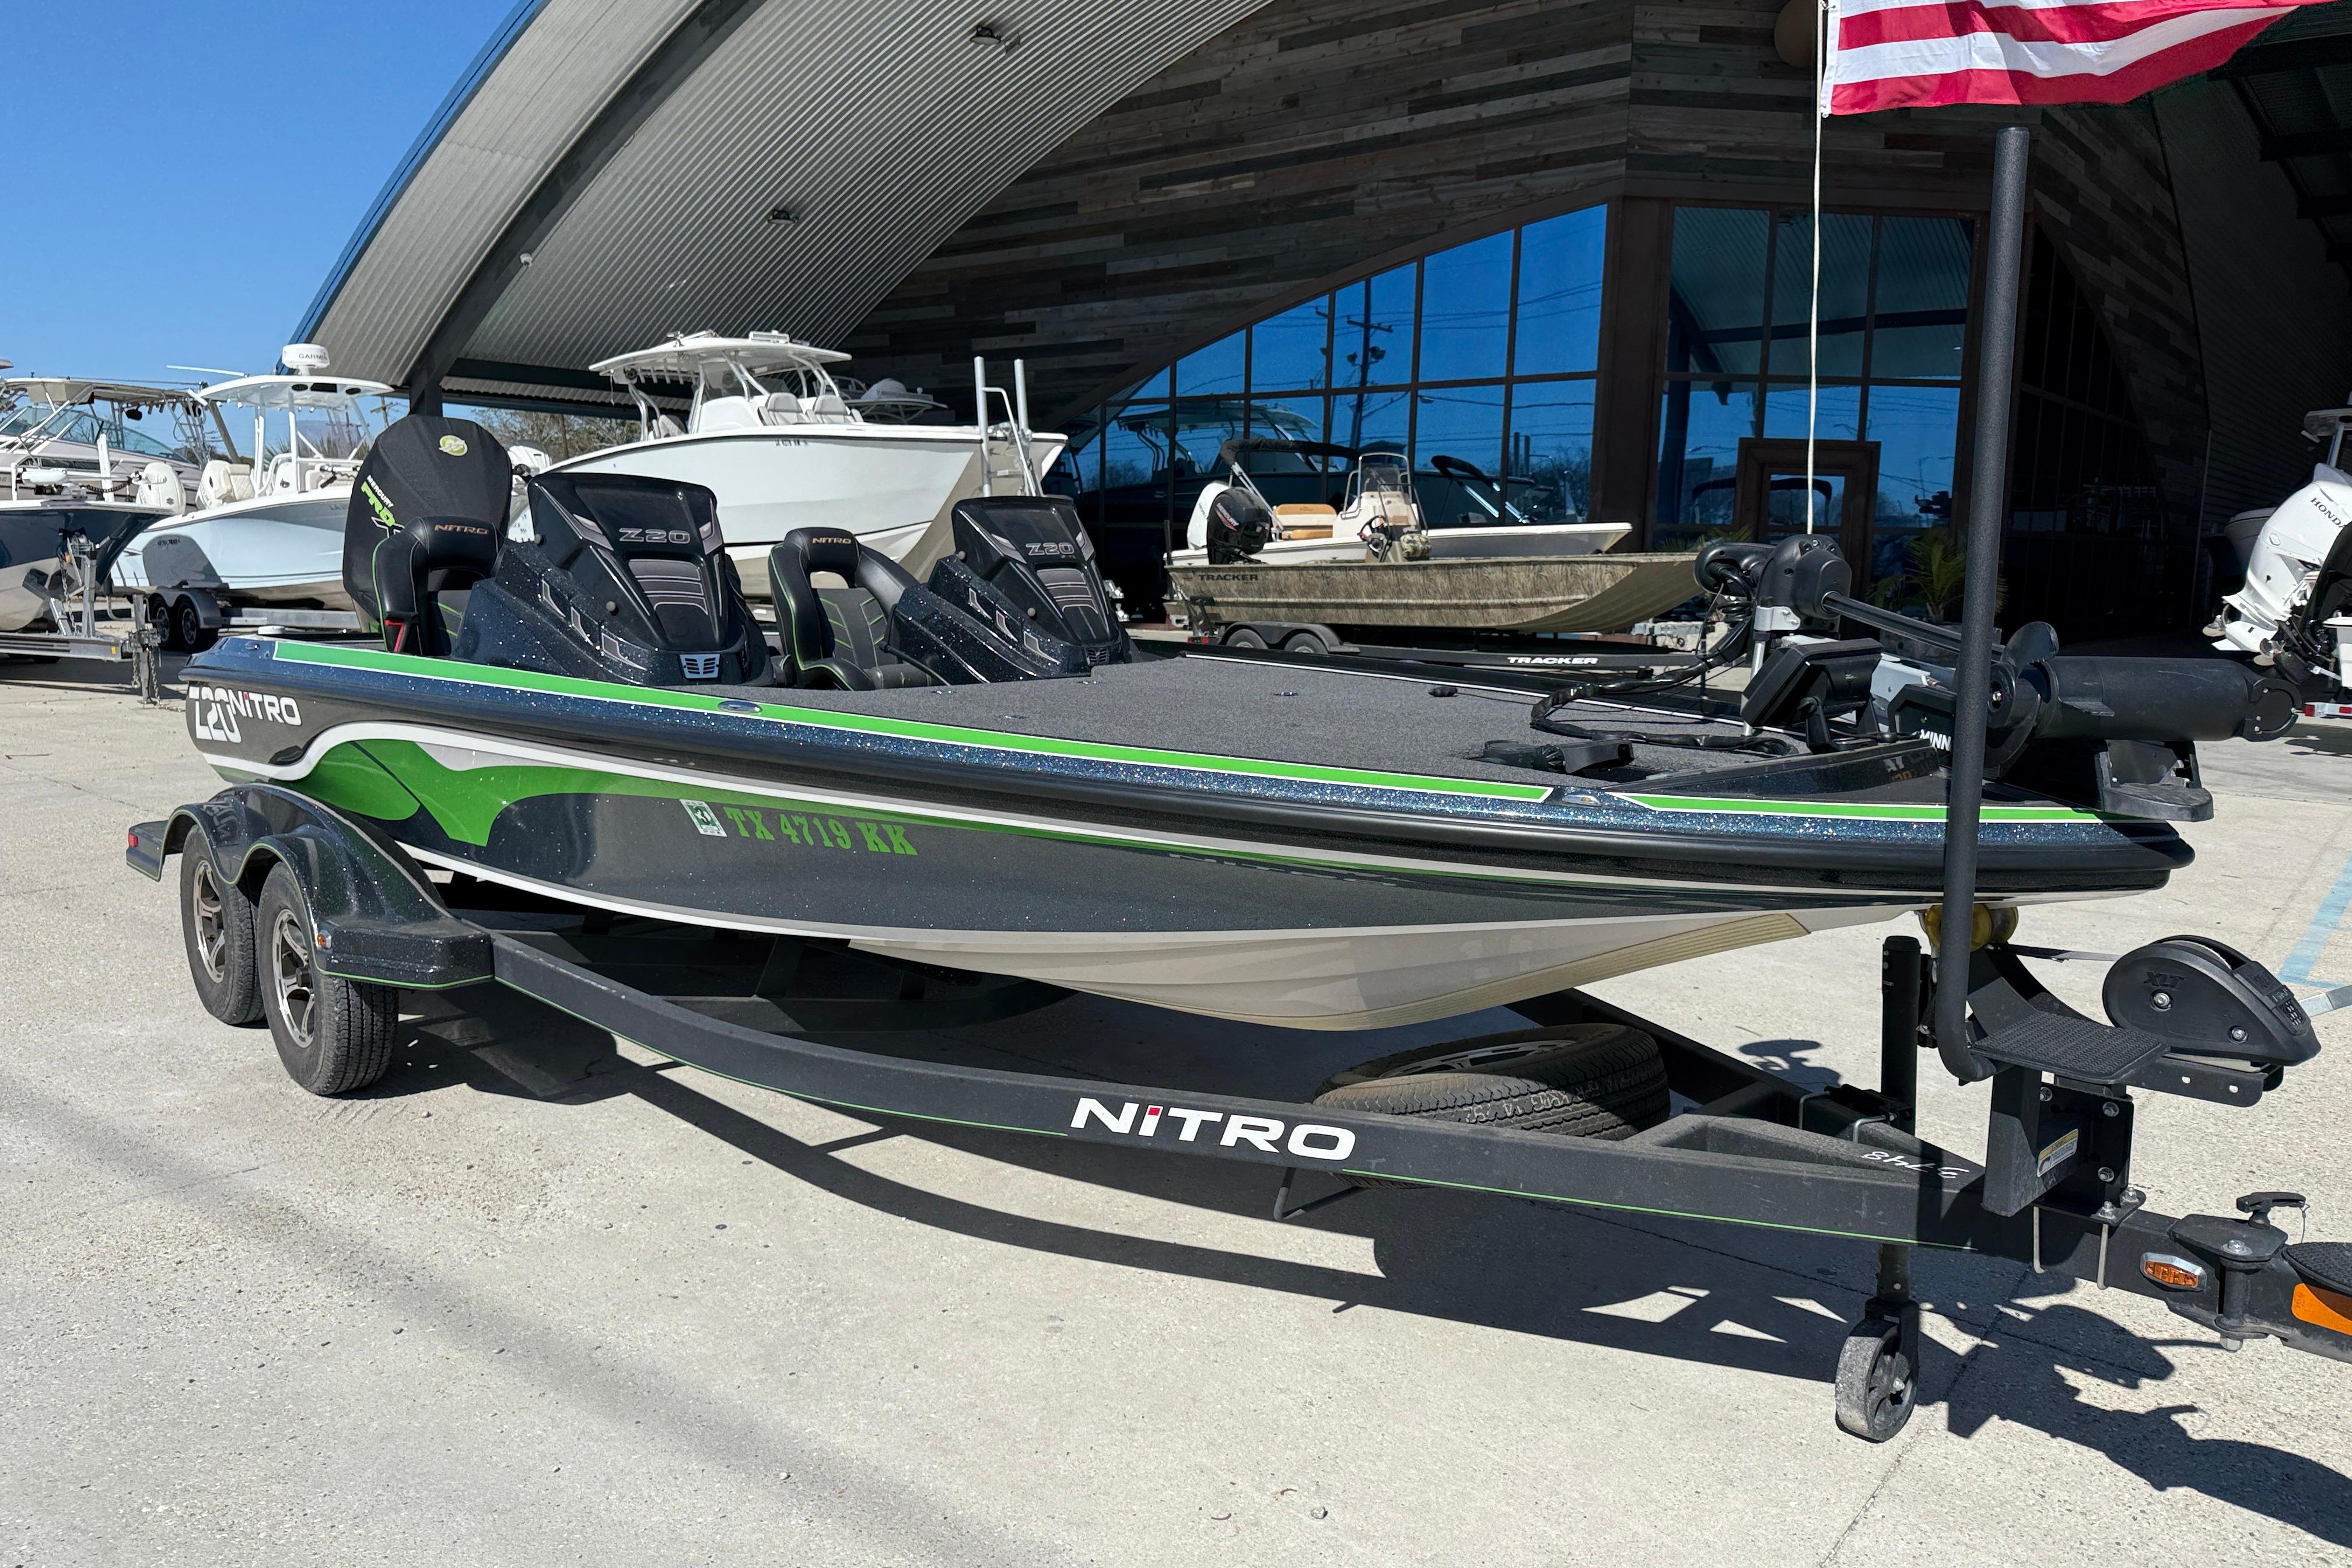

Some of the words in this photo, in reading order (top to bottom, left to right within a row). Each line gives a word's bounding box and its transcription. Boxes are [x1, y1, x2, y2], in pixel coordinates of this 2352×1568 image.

[367, 475, 394, 508] MERCURY
[360, 481, 396, 527] PRO
[435, 524, 489, 535] NITRO
[619, 527, 690, 544] Z20
[1026, 542, 1074, 555] Z20
[723, 807, 775, 841] TX
[780, 813, 852, 850] 4719
[855, 821, 919, 856] KK
[2144, 971, 2186, 988] XLT
